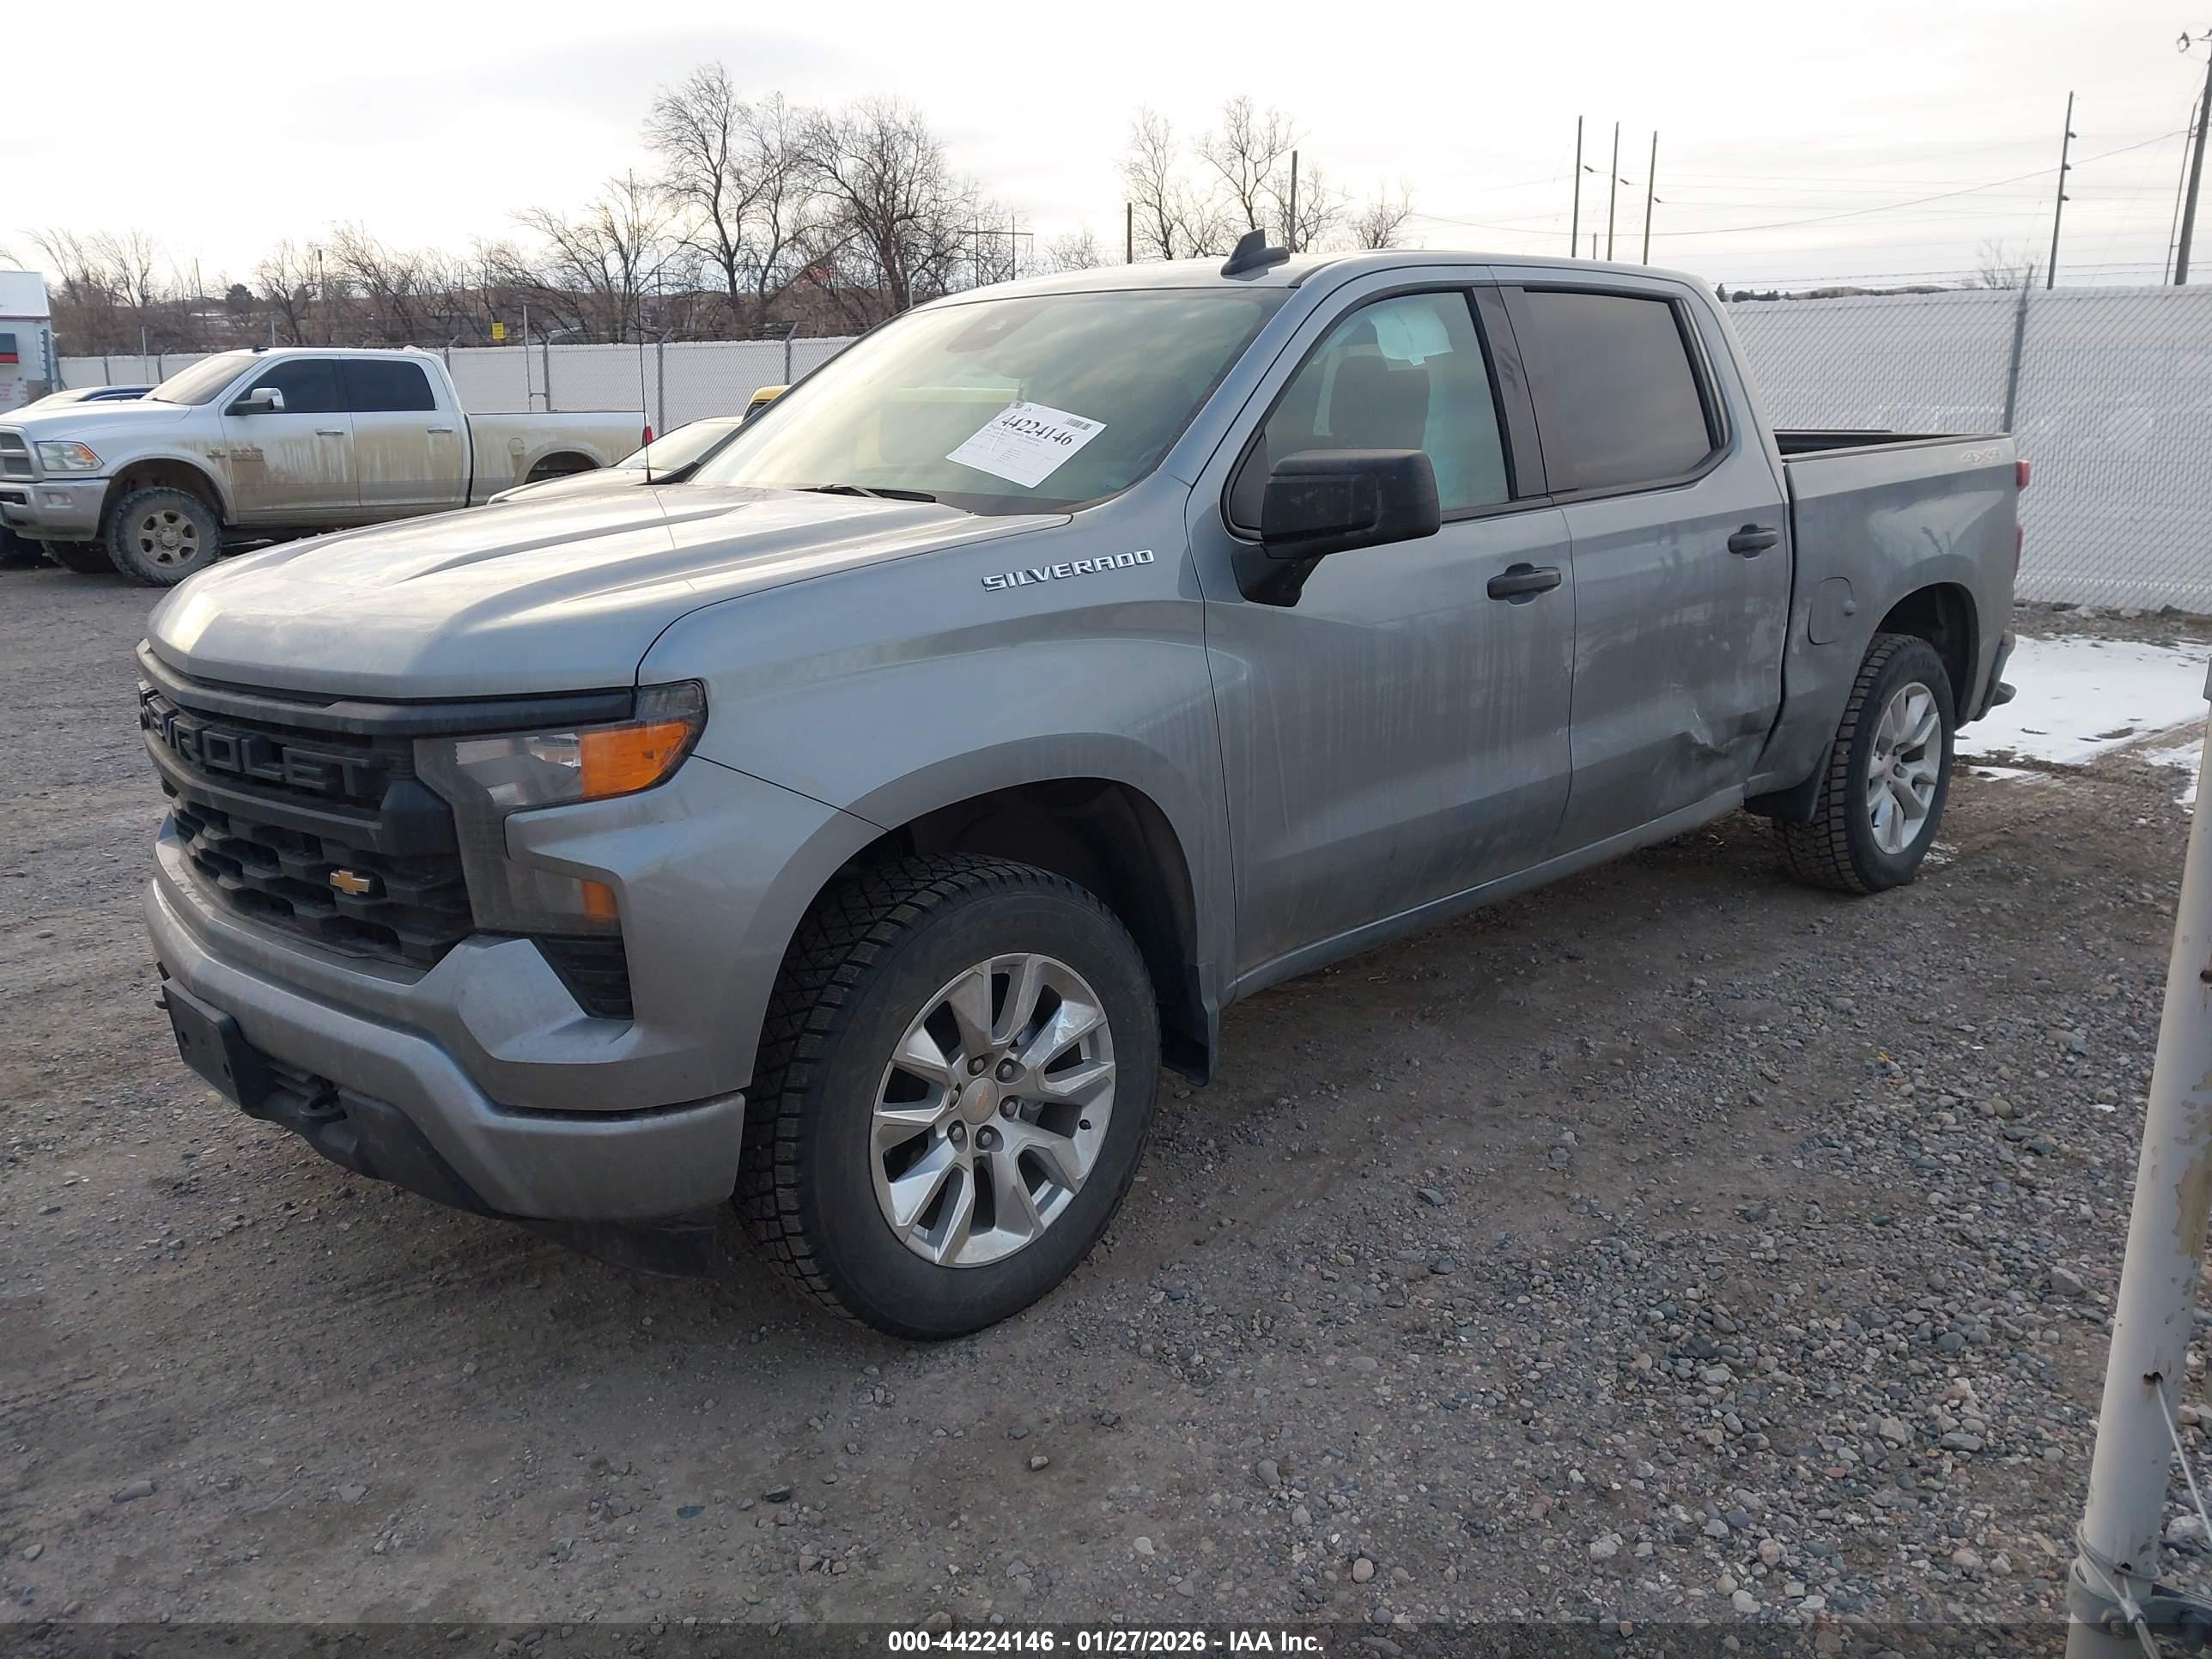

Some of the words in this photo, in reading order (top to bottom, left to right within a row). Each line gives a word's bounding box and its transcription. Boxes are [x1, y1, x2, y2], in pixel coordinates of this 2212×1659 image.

[1001, 415, 1079, 446] 44224146
[981, 550, 1155, 592] SILVERADO
[137, 679, 373, 797] EVROLET
